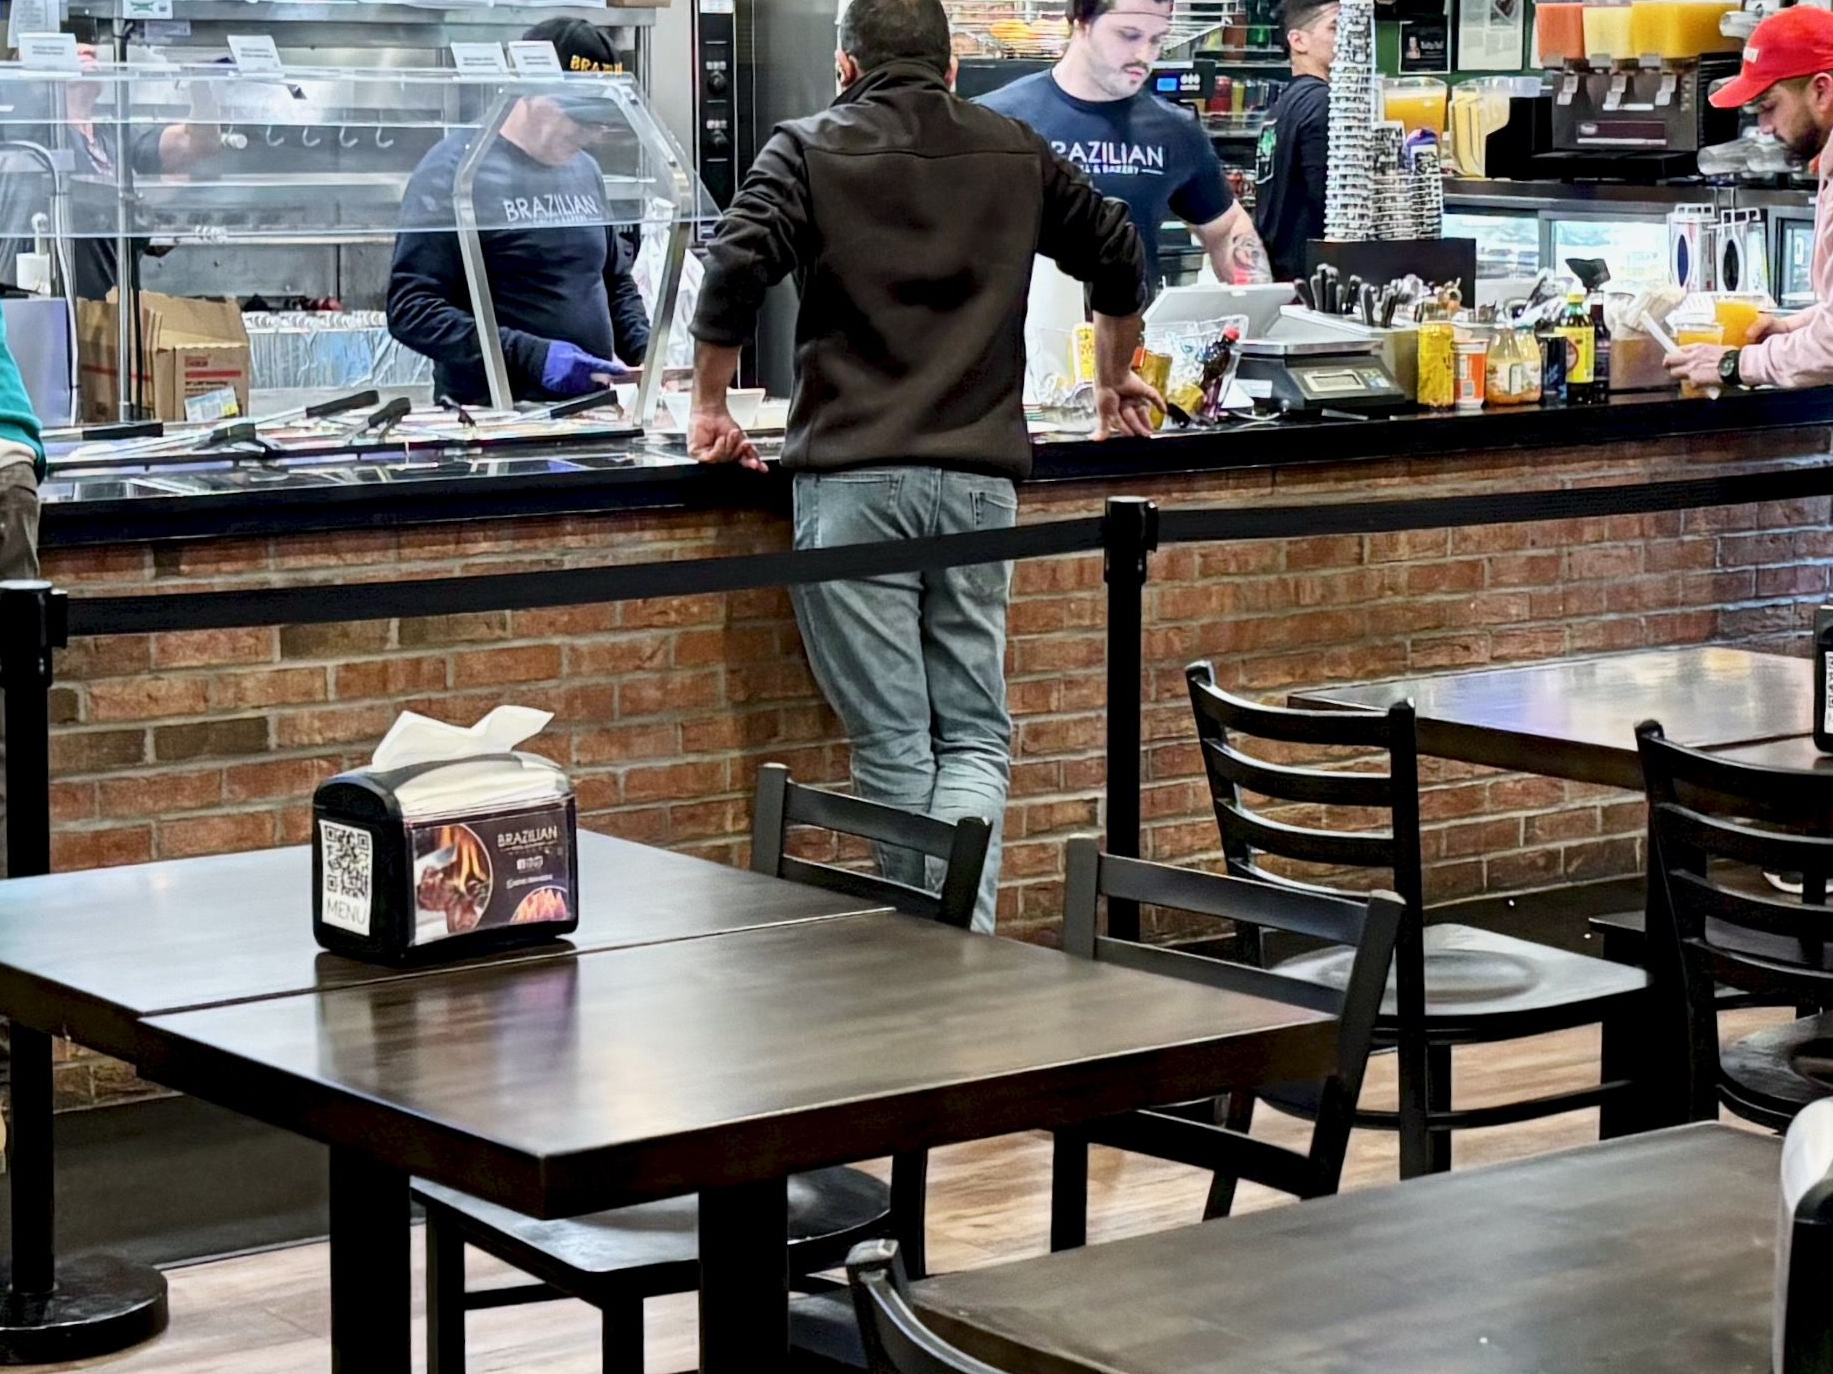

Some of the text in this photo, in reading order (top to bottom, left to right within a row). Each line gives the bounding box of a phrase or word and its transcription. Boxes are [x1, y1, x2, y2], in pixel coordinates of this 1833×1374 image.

[1051, 140, 1164, 168] RAZILIAN
[503, 192, 599, 223] BRAZILIAN
[497, 825, 558, 848] BRAZILIAN
[327, 896, 367, 925] MENU
